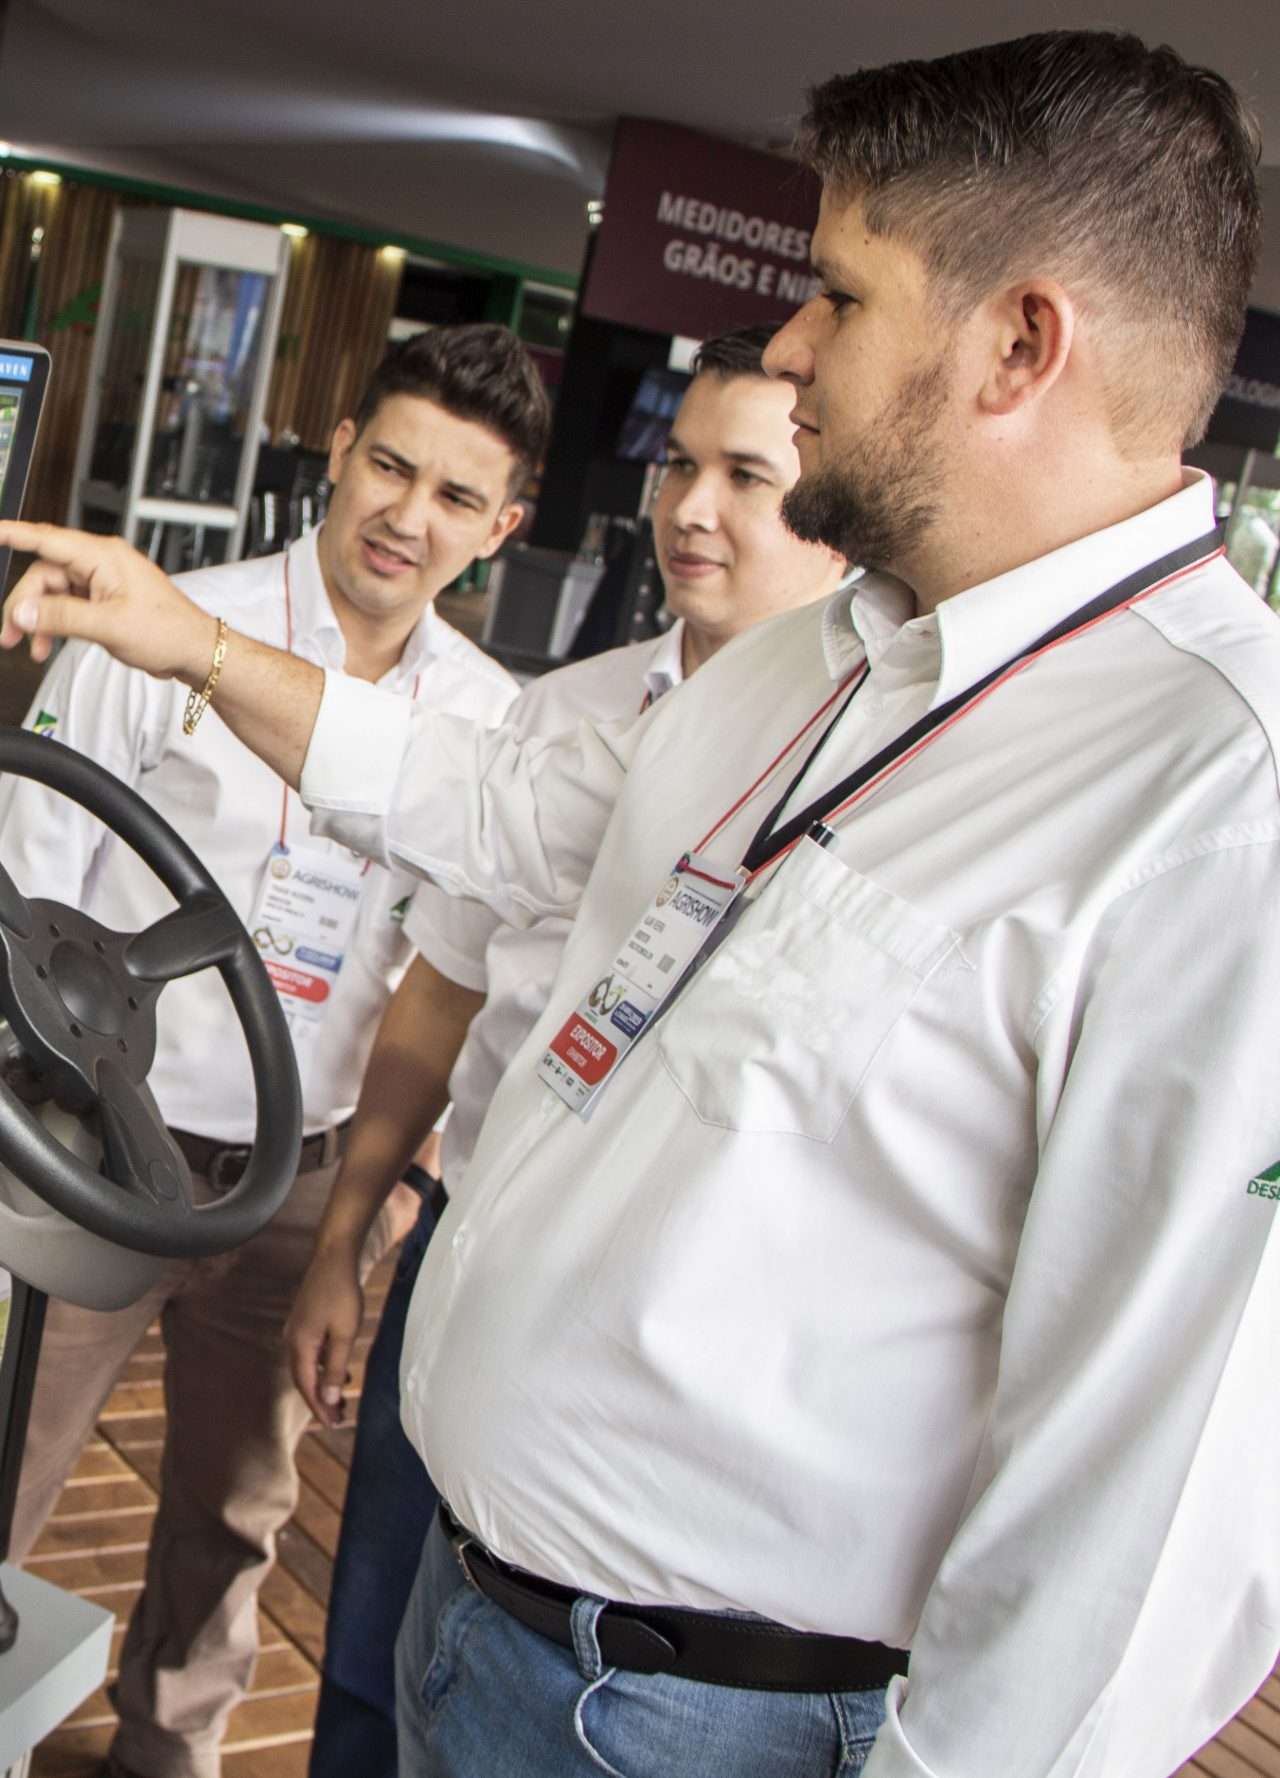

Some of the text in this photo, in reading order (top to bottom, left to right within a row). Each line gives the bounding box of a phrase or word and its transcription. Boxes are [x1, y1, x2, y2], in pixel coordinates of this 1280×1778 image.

[656, 190, 811, 261] MEDIDORES
[663, 239, 756, 290] GRÃOS
[755, 264, 777, 295] E
[669, 890, 719, 929] AGRISHOW
[570, 1023, 608, 1062] EXPOSITOR
